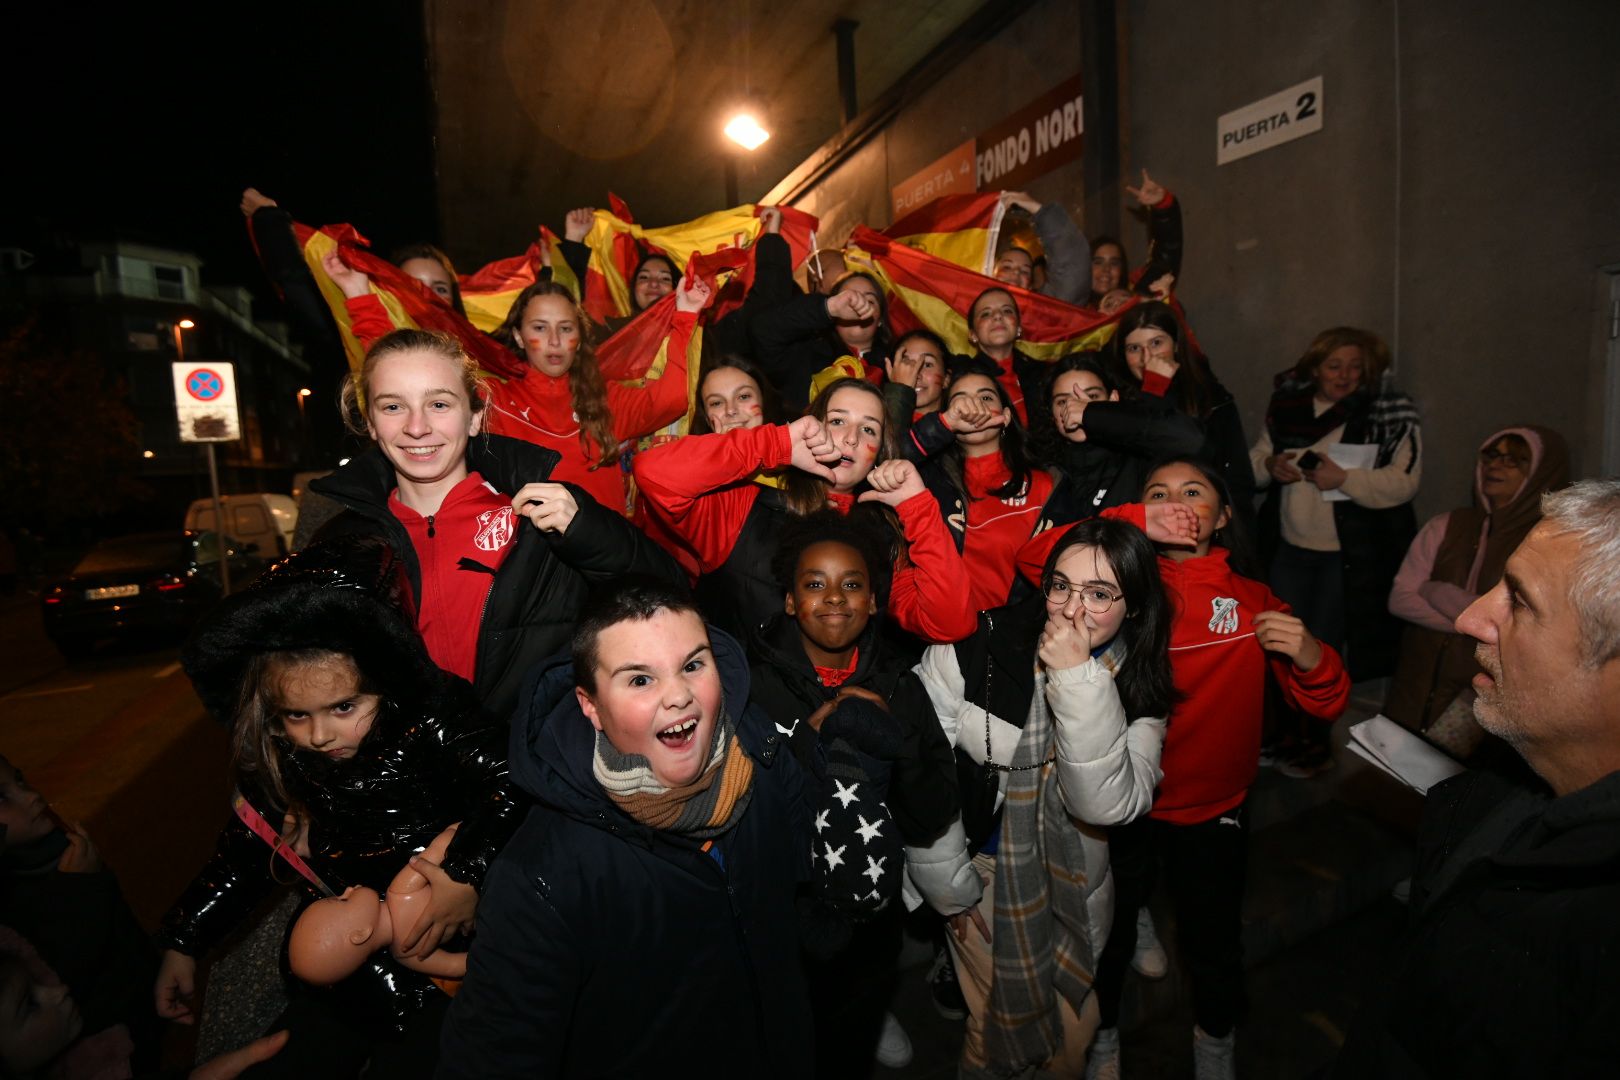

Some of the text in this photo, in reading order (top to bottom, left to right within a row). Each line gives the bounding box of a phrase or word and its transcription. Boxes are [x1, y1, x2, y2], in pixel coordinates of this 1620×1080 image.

[1223, 92, 1316, 149] PUERTA 2
[976, 127, 1030, 188] FONDO
[896, 160, 970, 214] PUERTA 4
